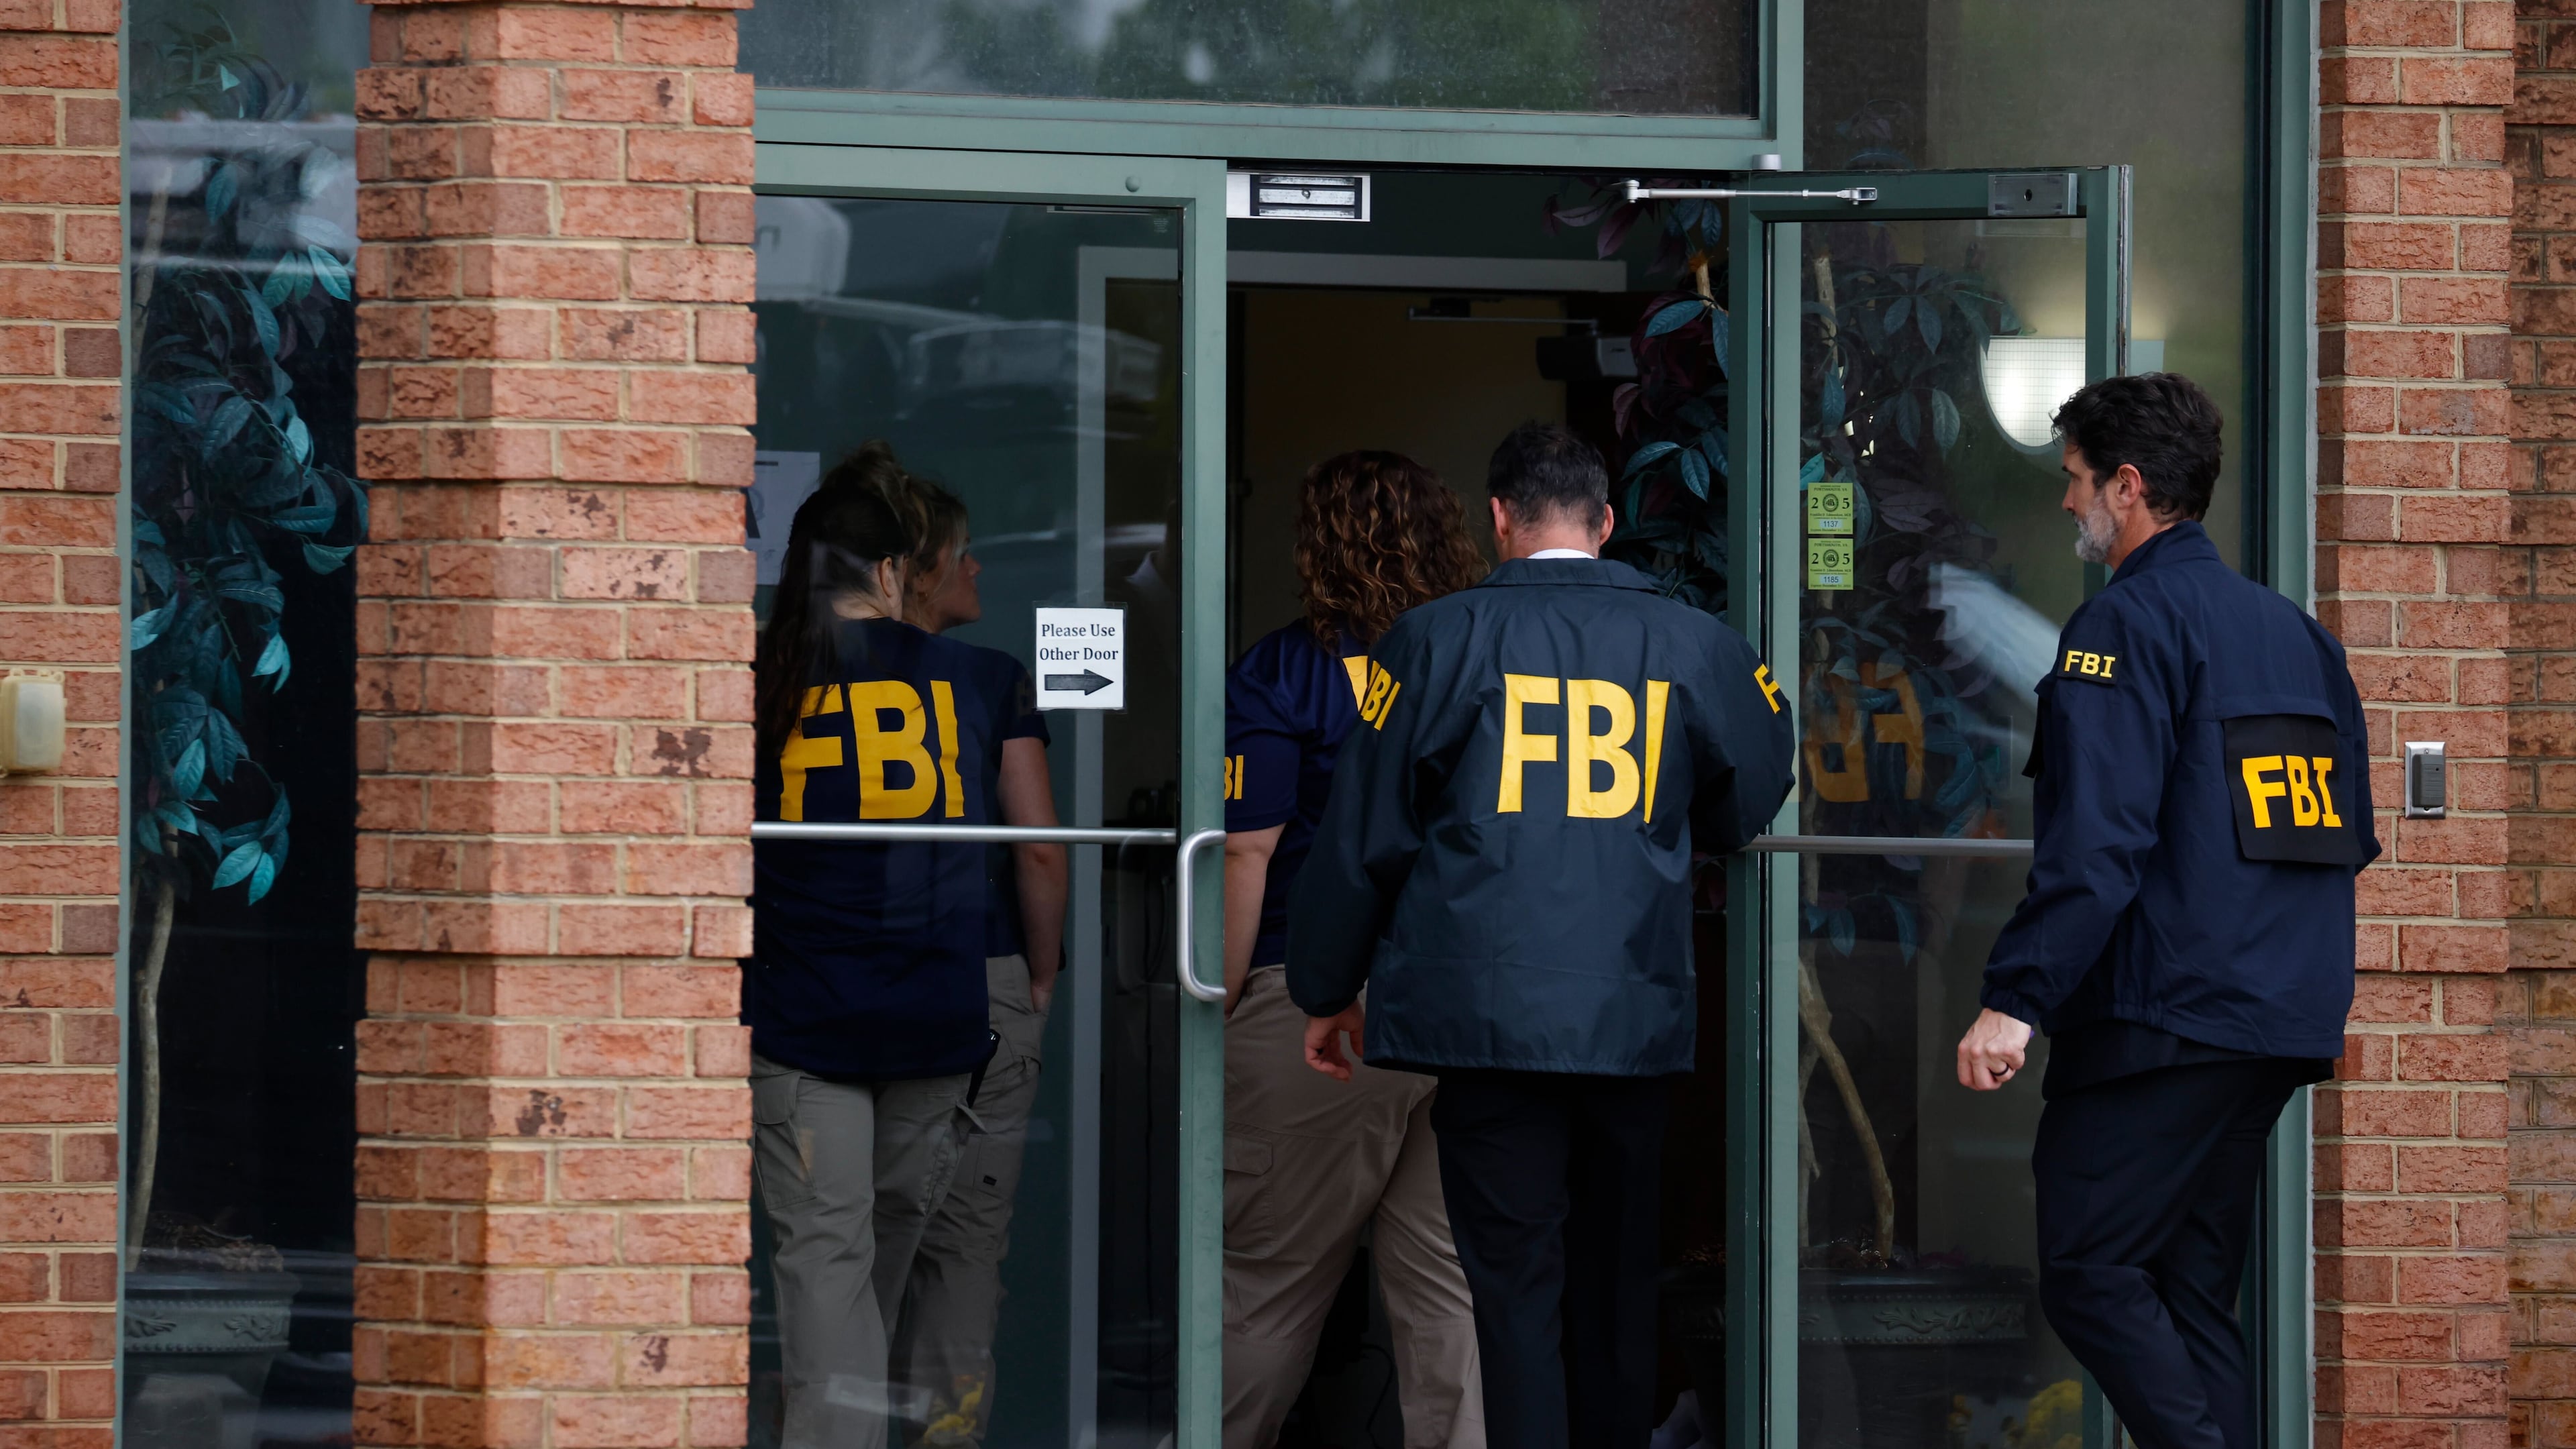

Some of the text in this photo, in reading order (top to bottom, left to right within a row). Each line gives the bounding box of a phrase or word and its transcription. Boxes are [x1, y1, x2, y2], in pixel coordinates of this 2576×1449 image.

[1040, 647, 1119, 660] Other Door
[1041, 624, 1116, 637] Please Use
[2064, 649, 2116, 678] FBI
[780, 680, 965, 822] FBI
[1497, 673, 1670, 824] FBI
[2242, 755, 2343, 828] FBI
